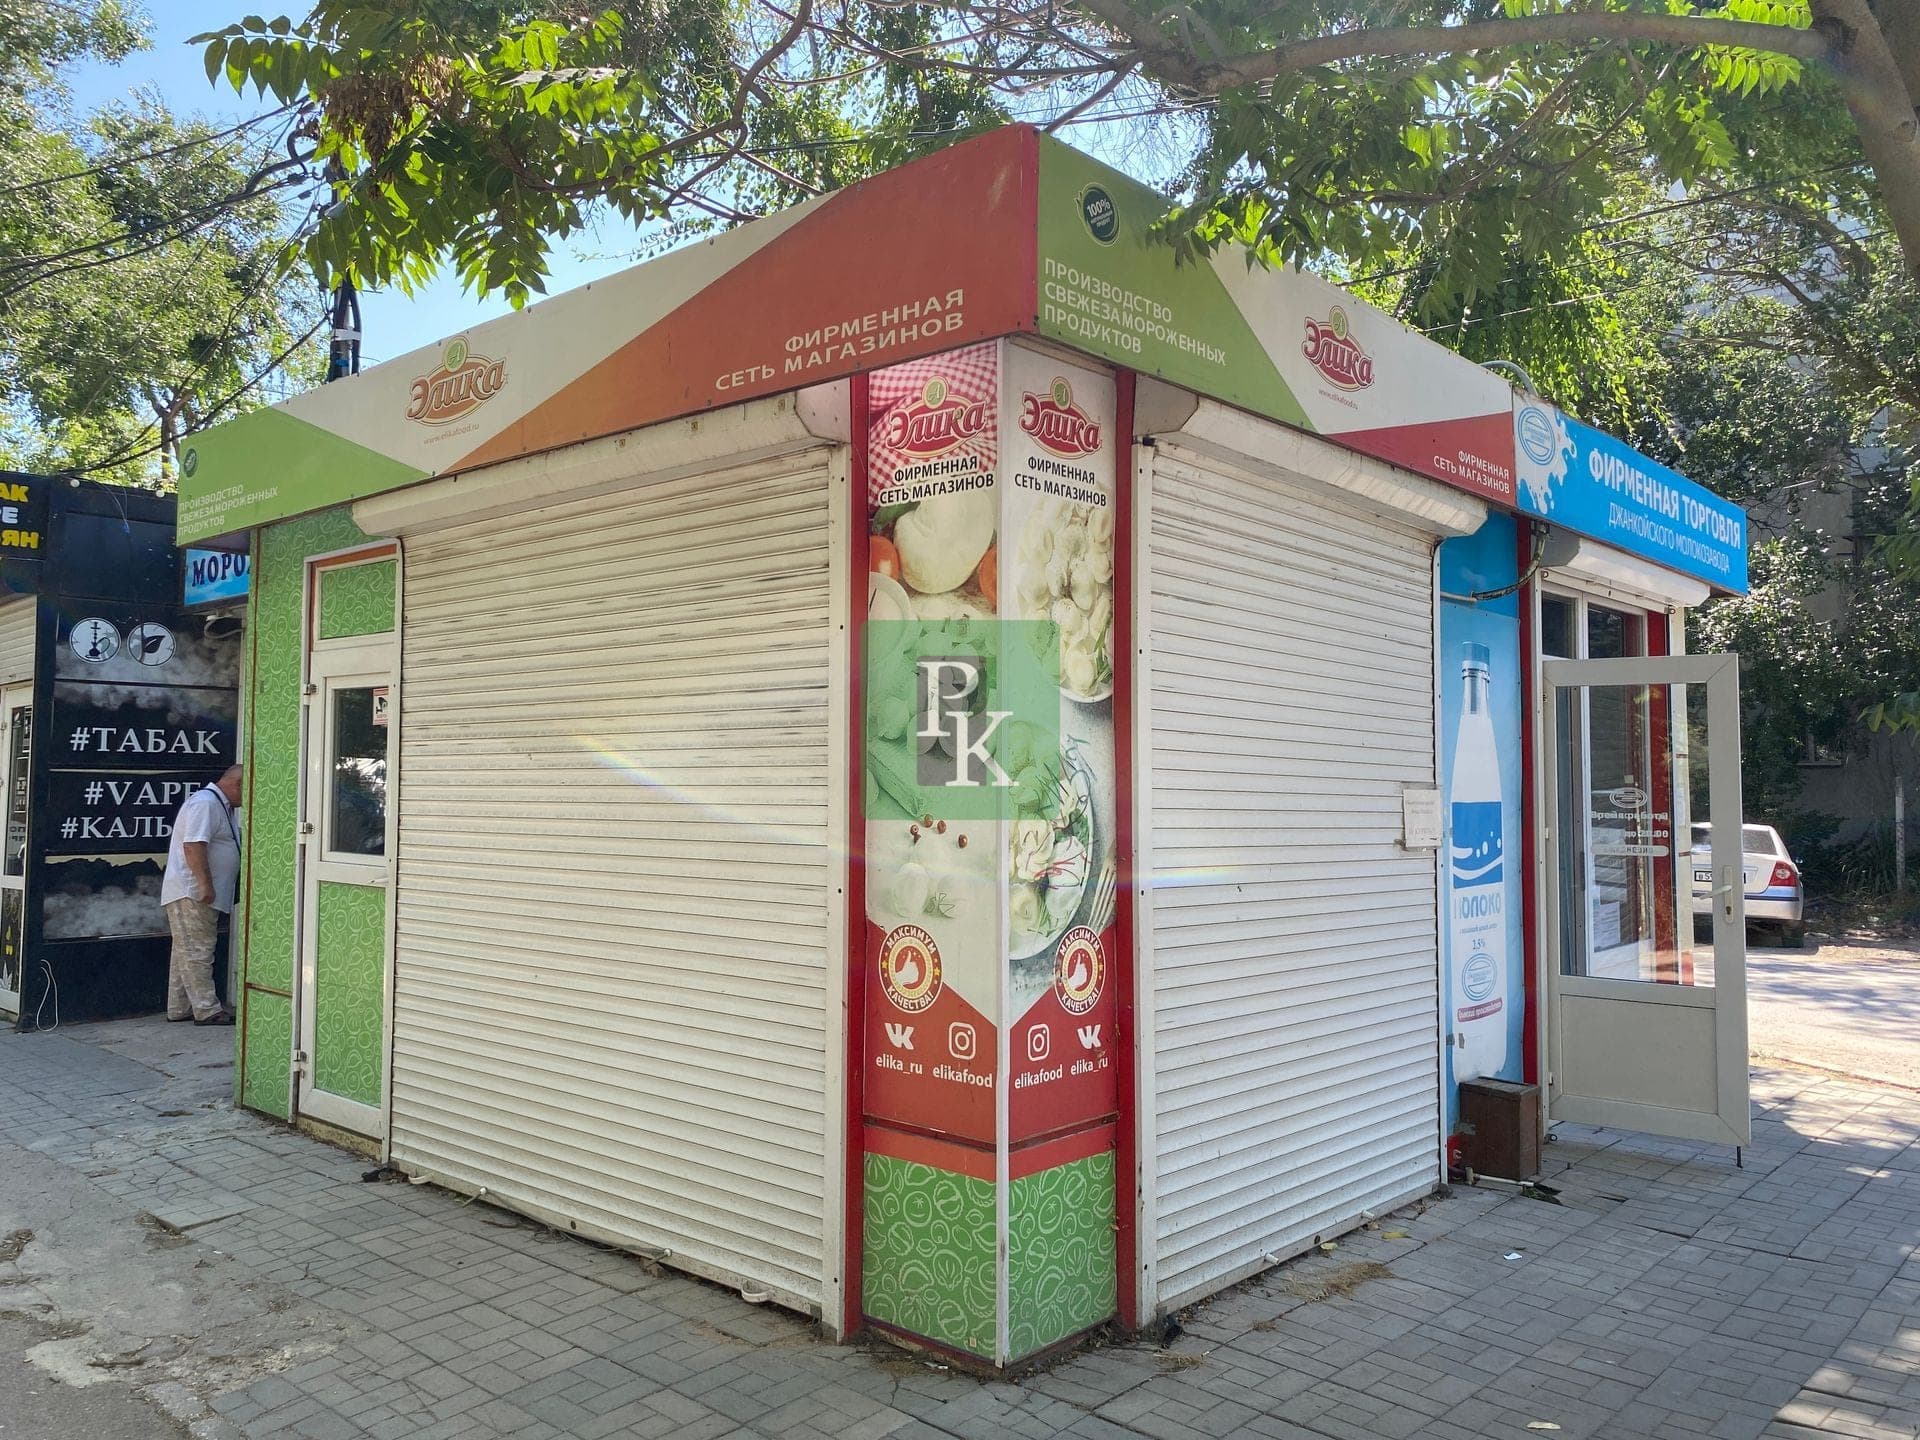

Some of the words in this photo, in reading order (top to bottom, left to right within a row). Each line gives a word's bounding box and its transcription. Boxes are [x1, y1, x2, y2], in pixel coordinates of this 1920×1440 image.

[1087, 198, 1110, 217] 100%
[1045, 257, 1172, 323] ПРОИЗВОДСТВО
[784, 288, 964, 352] ФИРМЕННАЯ
[1044, 281, 1227, 367] СВЕЖЕЗАМОРОЖЕННЫХ
[1044, 303, 1142, 354] ПРОДУКТОВ
[715, 364, 776, 391] СЕТЬ
[784, 312, 964, 374] МАГАЗИНОВ
[1302, 317, 1374, 389] Элика
[406, 359, 505, 420] Элика
[885, 400, 988, 450] Элика
[1018, 390, 1103, 453] Элика
[894, 455, 978, 483] ФИРМЕННАЯ
[1028, 456, 1095, 485] ФИРМЕННАЯ
[1433, 455, 1456, 473] СЕТЬ
[1459, 464, 1510, 494] МАГАЗИНОВ
[1458, 450, 1509, 480] ФИРМЕННАЯ
[178, 484, 244, 511] ПРОИЗВОДСТВО
[179, 486, 279, 524] СВЕЖЕЗАМОРОЖЕННЫХ
[879, 488, 910, 505] СЕТЬ
[912, 473, 994, 501] МАГАЗИНОВ
[1014, 473, 1041, 491] СЕТЬ
[1043, 479, 1107, 507] МАГАЗИНОВ
[1588, 448, 1679, 521] ФИРМЕННАЯ
[1682, 494, 1741, 550] ТОРГОВЛЯ
[178, 515, 225, 535] ПРОДУКТОВ
[1609, 502, 1675, 550] ДЖАНКОЙСКОГО
[1676, 532, 1730, 575] МОЛОКОЗАВОДА
[191, 553, 250, 587] МОРО
[70, 726, 221, 754] #ТАБАК
[886, 926, 937, 954] МАКСИМУМ
[1059, 929, 1100, 956] МАКСИМУМ
[887, 985, 934, 1010] КАЧЕСТВА!
[1061, 987, 1099, 1012] КАЧЕСТВА!
[876, 1053, 923, 1075] elika_ru
[932, 1064, 993, 1089] elikafood
[1014, 1064, 1063, 1089] elikafood
[1070, 1055, 1109, 1076] elika_ru
